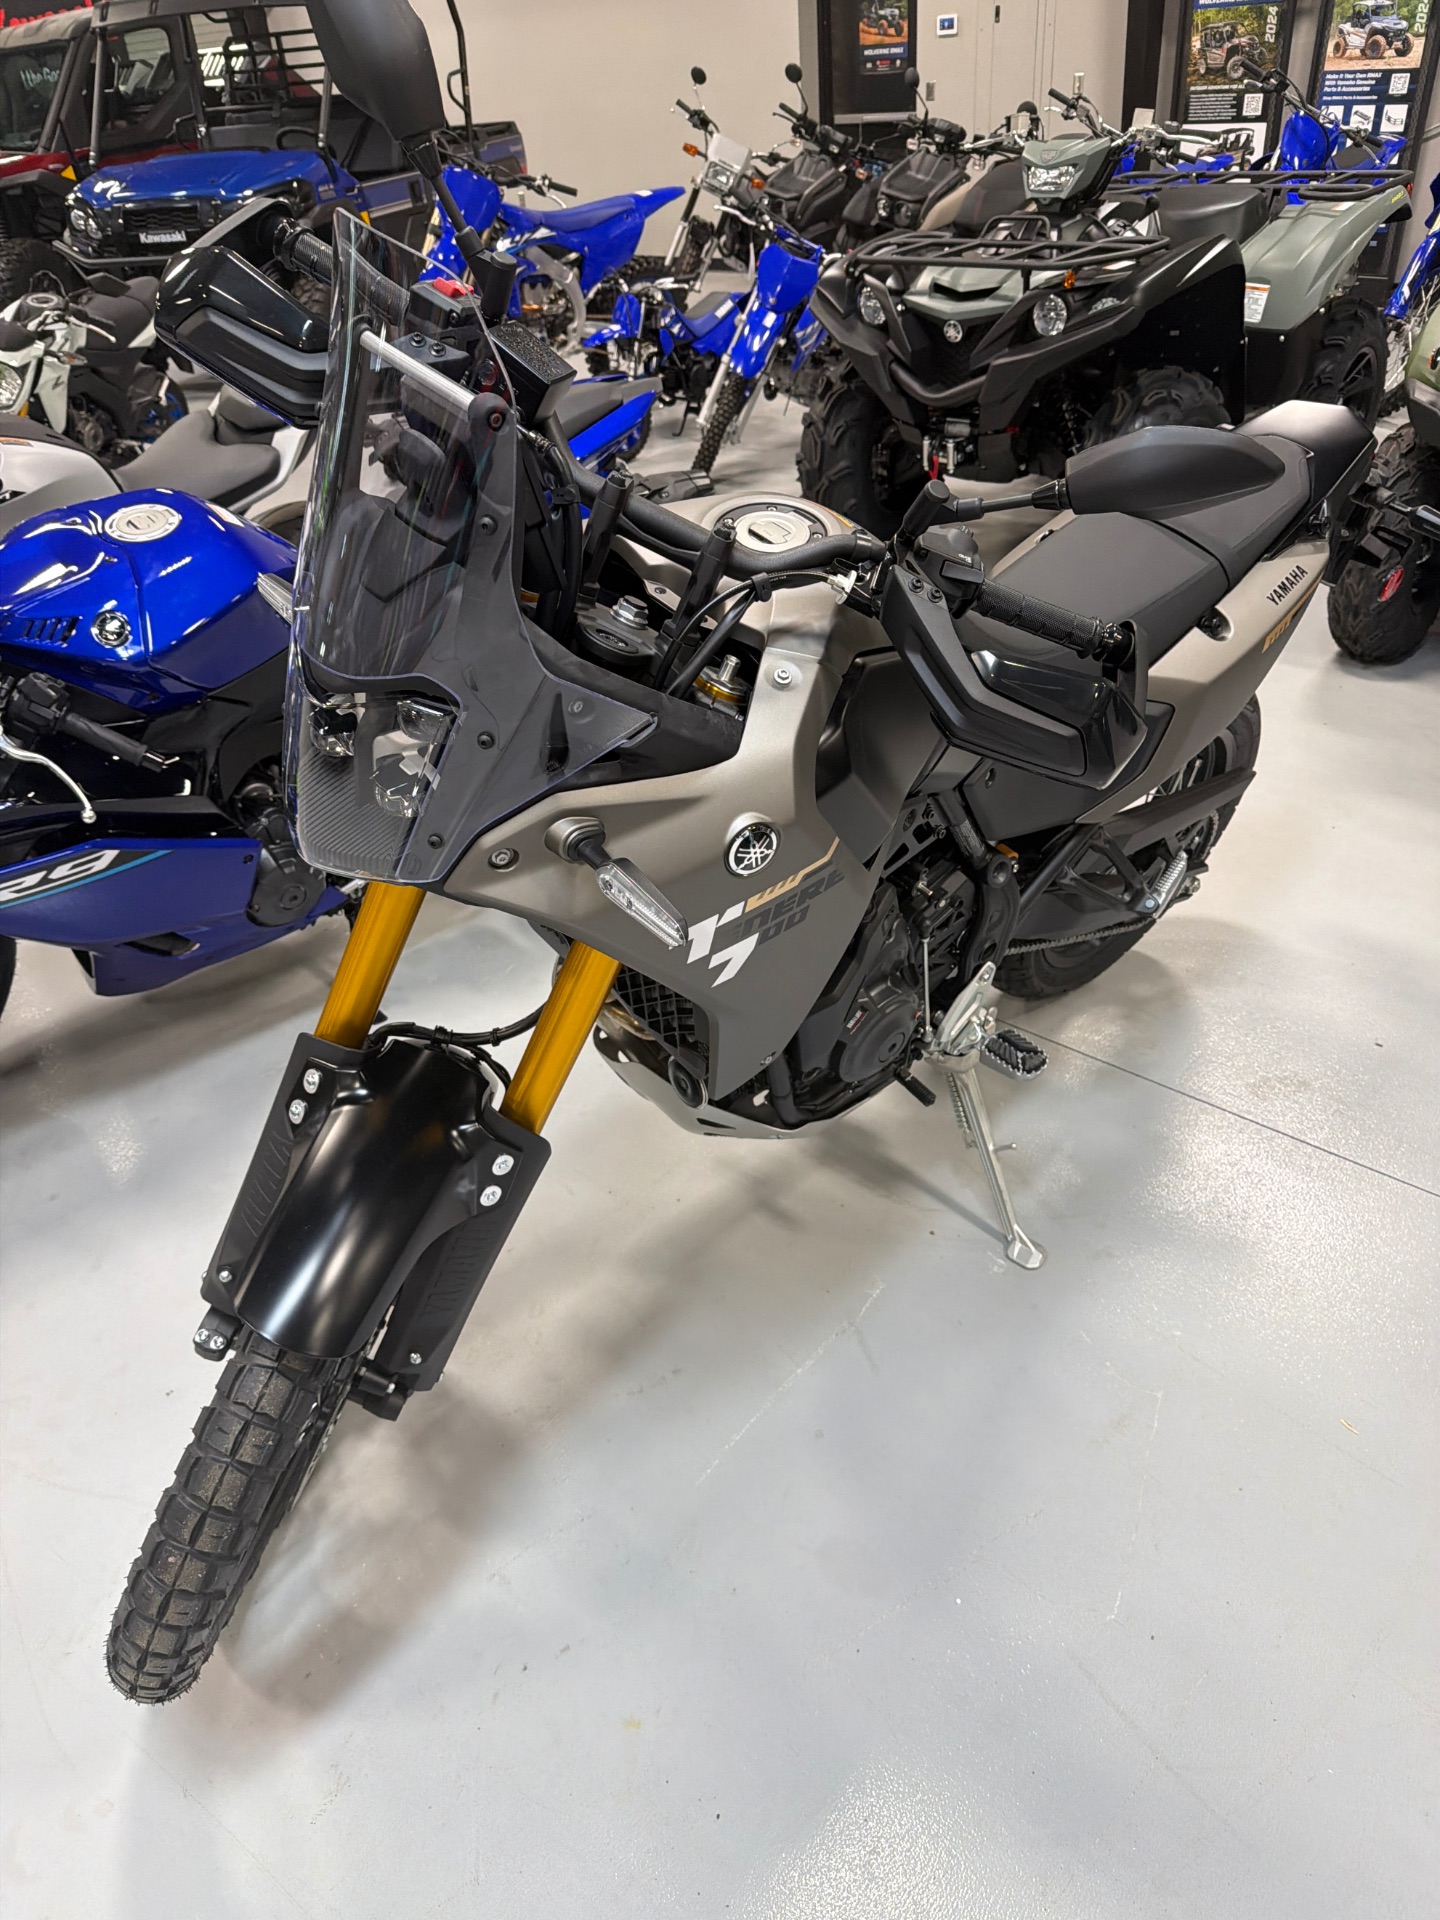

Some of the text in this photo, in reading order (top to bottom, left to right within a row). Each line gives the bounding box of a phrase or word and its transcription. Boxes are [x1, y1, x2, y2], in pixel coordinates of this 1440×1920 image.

[1265, 5, 1278, 42] 2024
[139, 230, 187, 244] Kawasaki
[1266, 565, 1308, 606] YAMAHA
